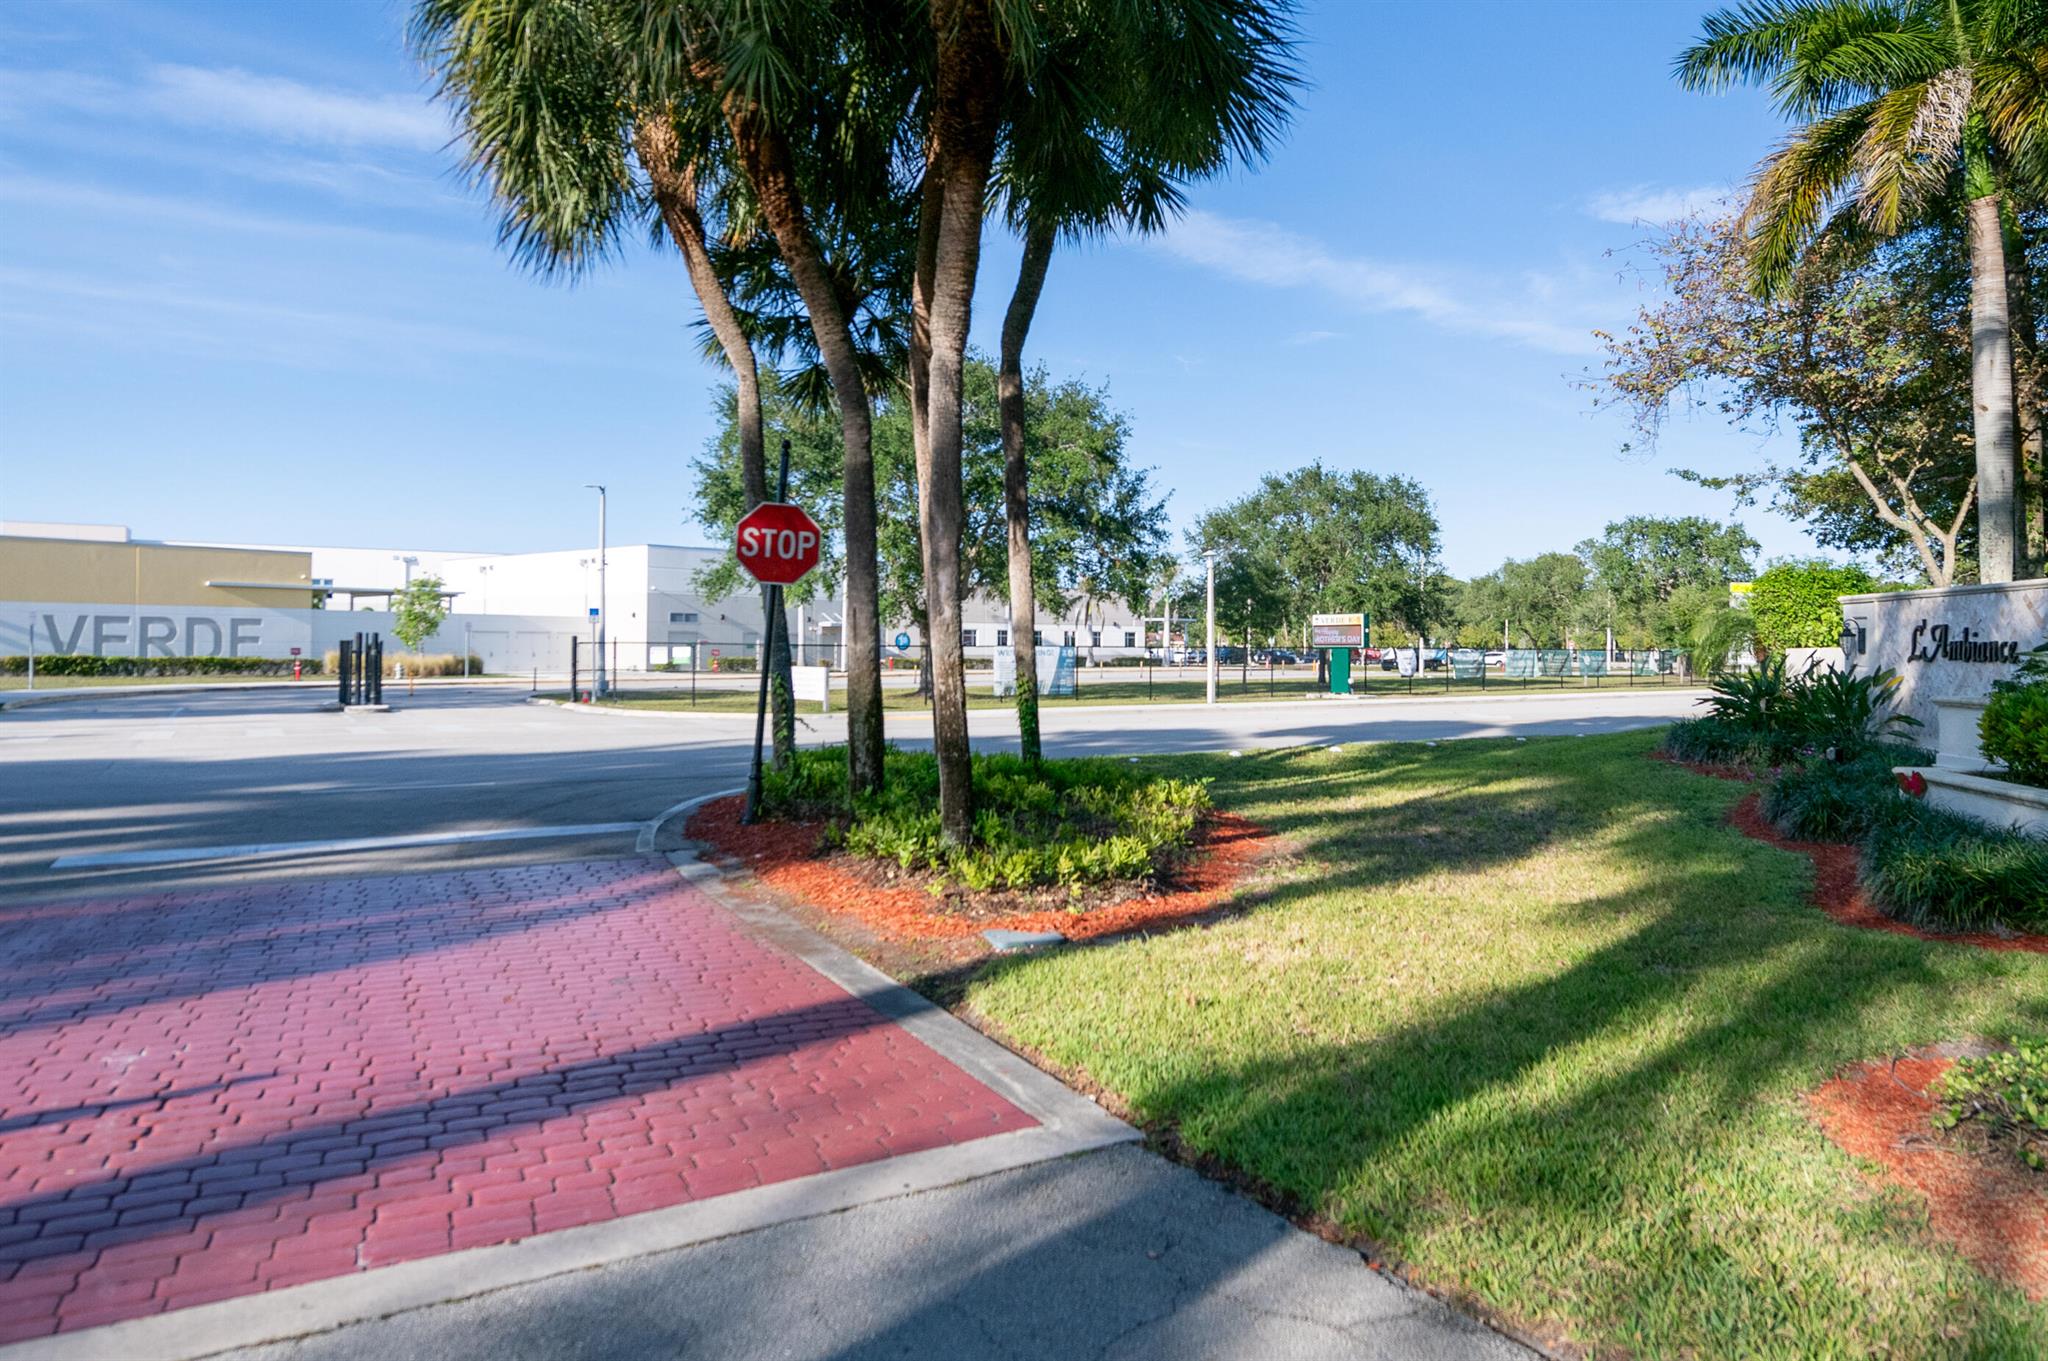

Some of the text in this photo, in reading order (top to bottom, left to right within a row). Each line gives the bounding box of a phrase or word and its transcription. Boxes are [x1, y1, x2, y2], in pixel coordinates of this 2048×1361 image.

[741, 526, 816, 560] STOP
[42, 614, 264, 657] VERDE
[1907, 618, 2019, 665] L'Ambiance
